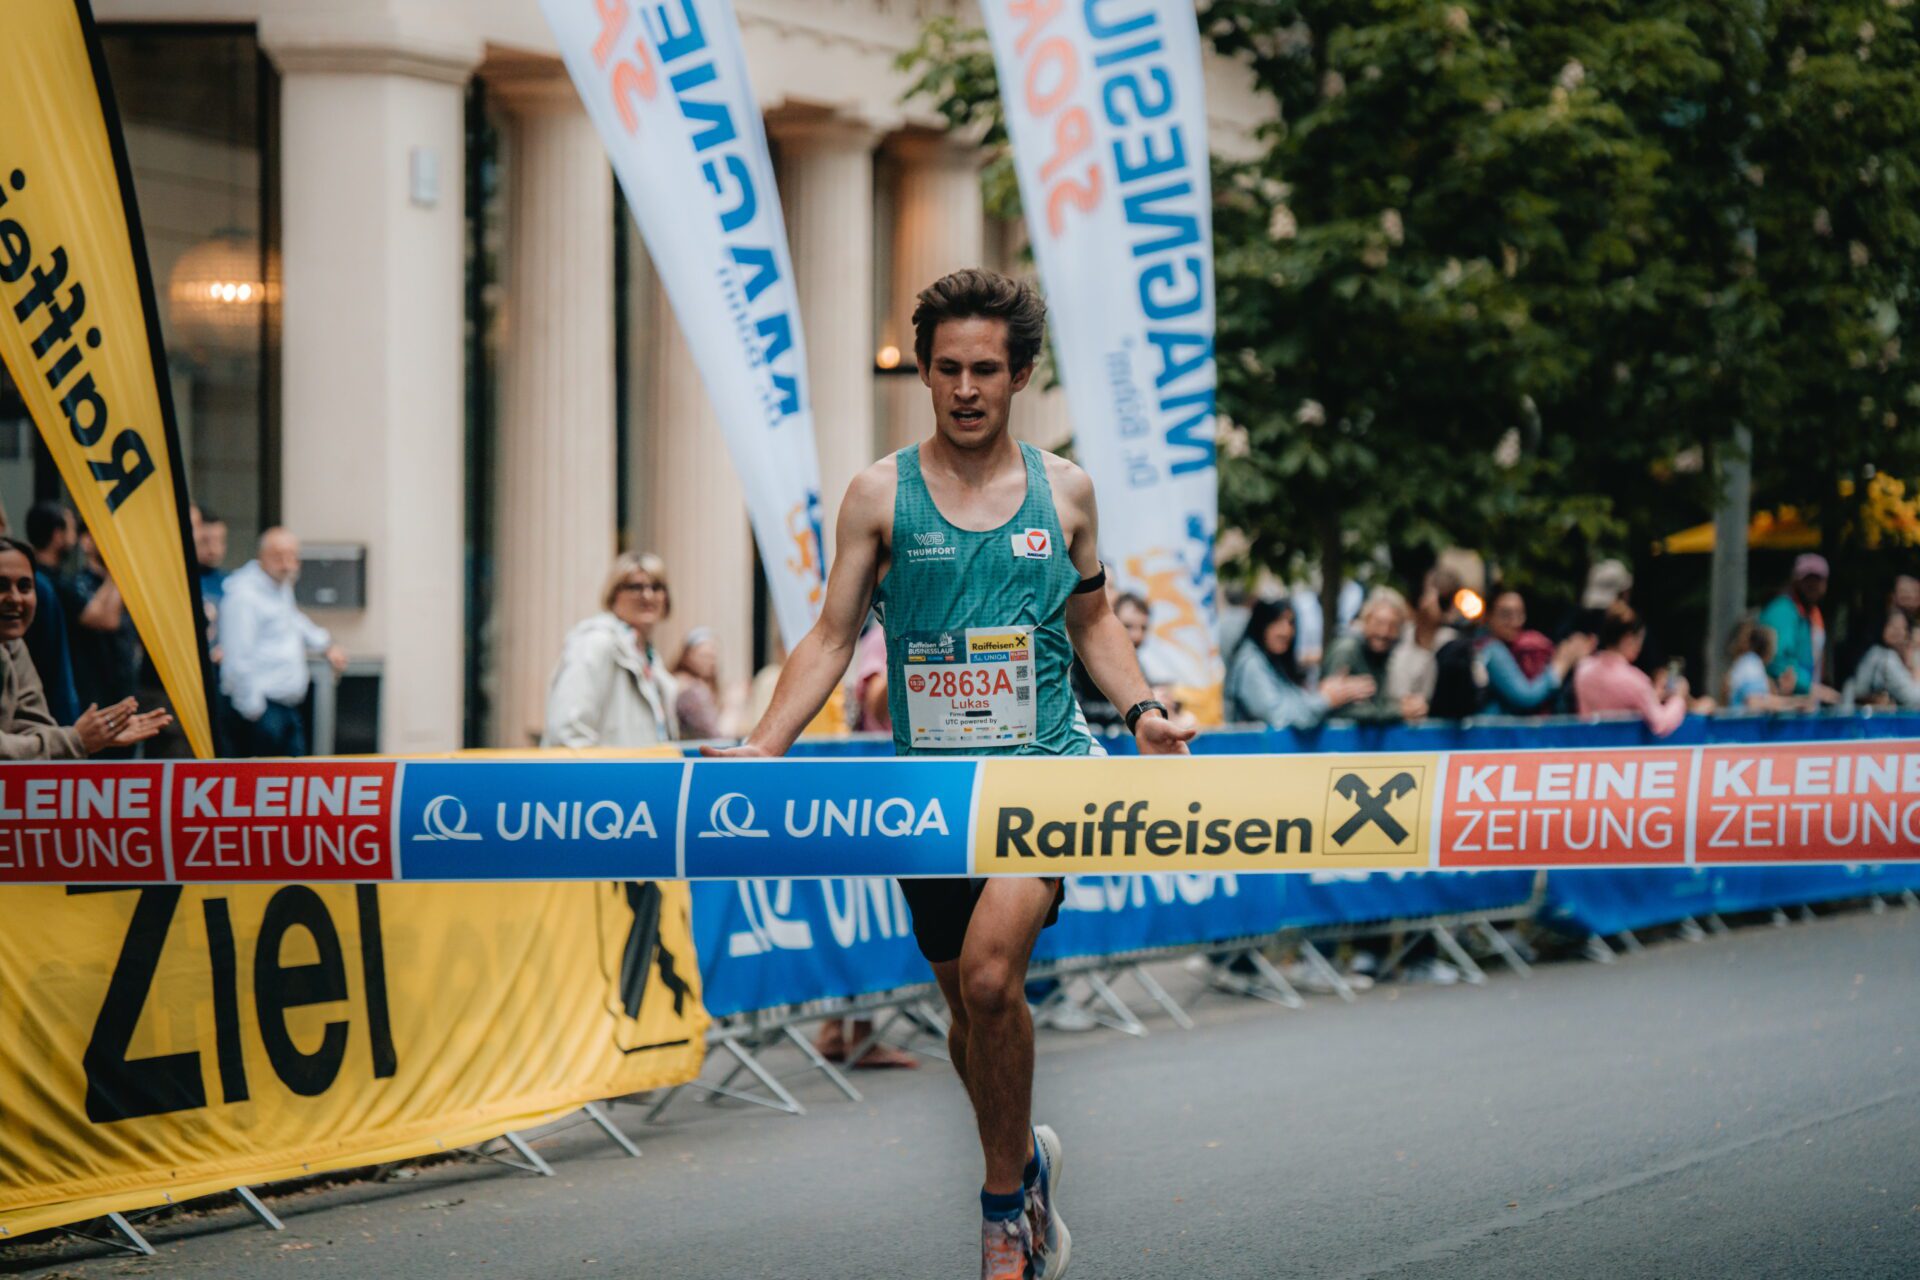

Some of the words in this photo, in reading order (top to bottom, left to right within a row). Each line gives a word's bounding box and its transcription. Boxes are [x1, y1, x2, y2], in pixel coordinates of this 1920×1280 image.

[907, 546, 956, 557] THUMFORT
[972, 641, 1014, 651] Raiffeisen
[929, 668, 1014, 698] 2863A
[952, 698, 990, 710] Lukas
[182, 776, 384, 818] KLEINE
[1457, 761, 1679, 803] KLEINE
[496, 800, 659, 841] UNIQA
[784, 797, 950, 838] UNIQA
[995, 800, 1313, 859] Raiffeisen
[1452, 806, 1674, 852] ZEITUNG
[182, 824, 381, 867] ZEITUNG
[66, 884, 397, 1124] Ziel
